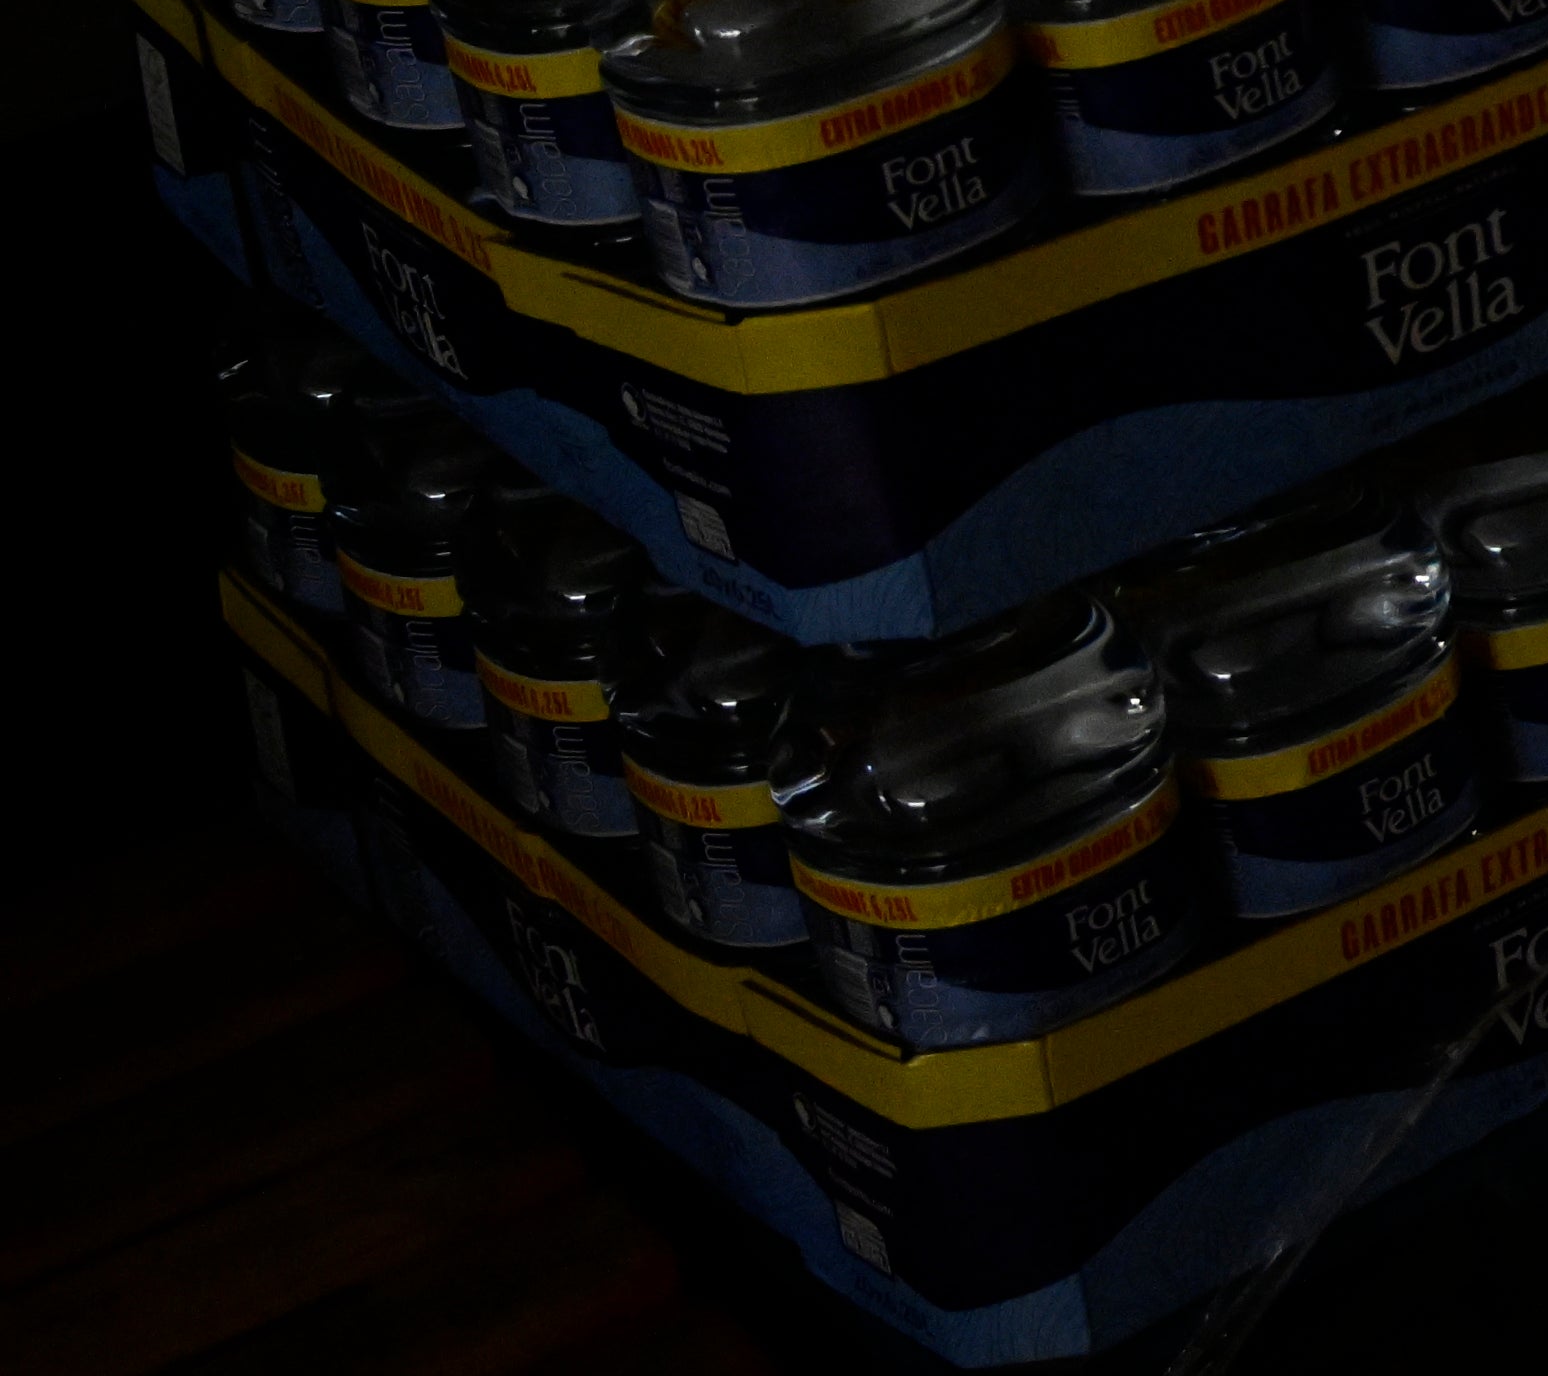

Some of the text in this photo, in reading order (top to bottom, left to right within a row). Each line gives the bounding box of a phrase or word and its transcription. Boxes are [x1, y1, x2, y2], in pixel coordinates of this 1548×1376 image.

[1207, 30, 1294, 90] Font
[1214, 67, 1304, 123] Vella
[879, 135, 981, 197] Font
[885, 173, 988, 230] Vella
[1196, 170, 1340, 257] GARRAFA
[1360, 207, 1515, 313] Font
[1363, 269, 1526, 367] Vella
[1357, 751, 1438, 816] Font
[1363, 786, 1446, 845] Vella
[1064, 876, 1153, 943] Font
[1340, 868, 1471, 962] GARRAFA
[1068, 913, 1162, 975] Vella
